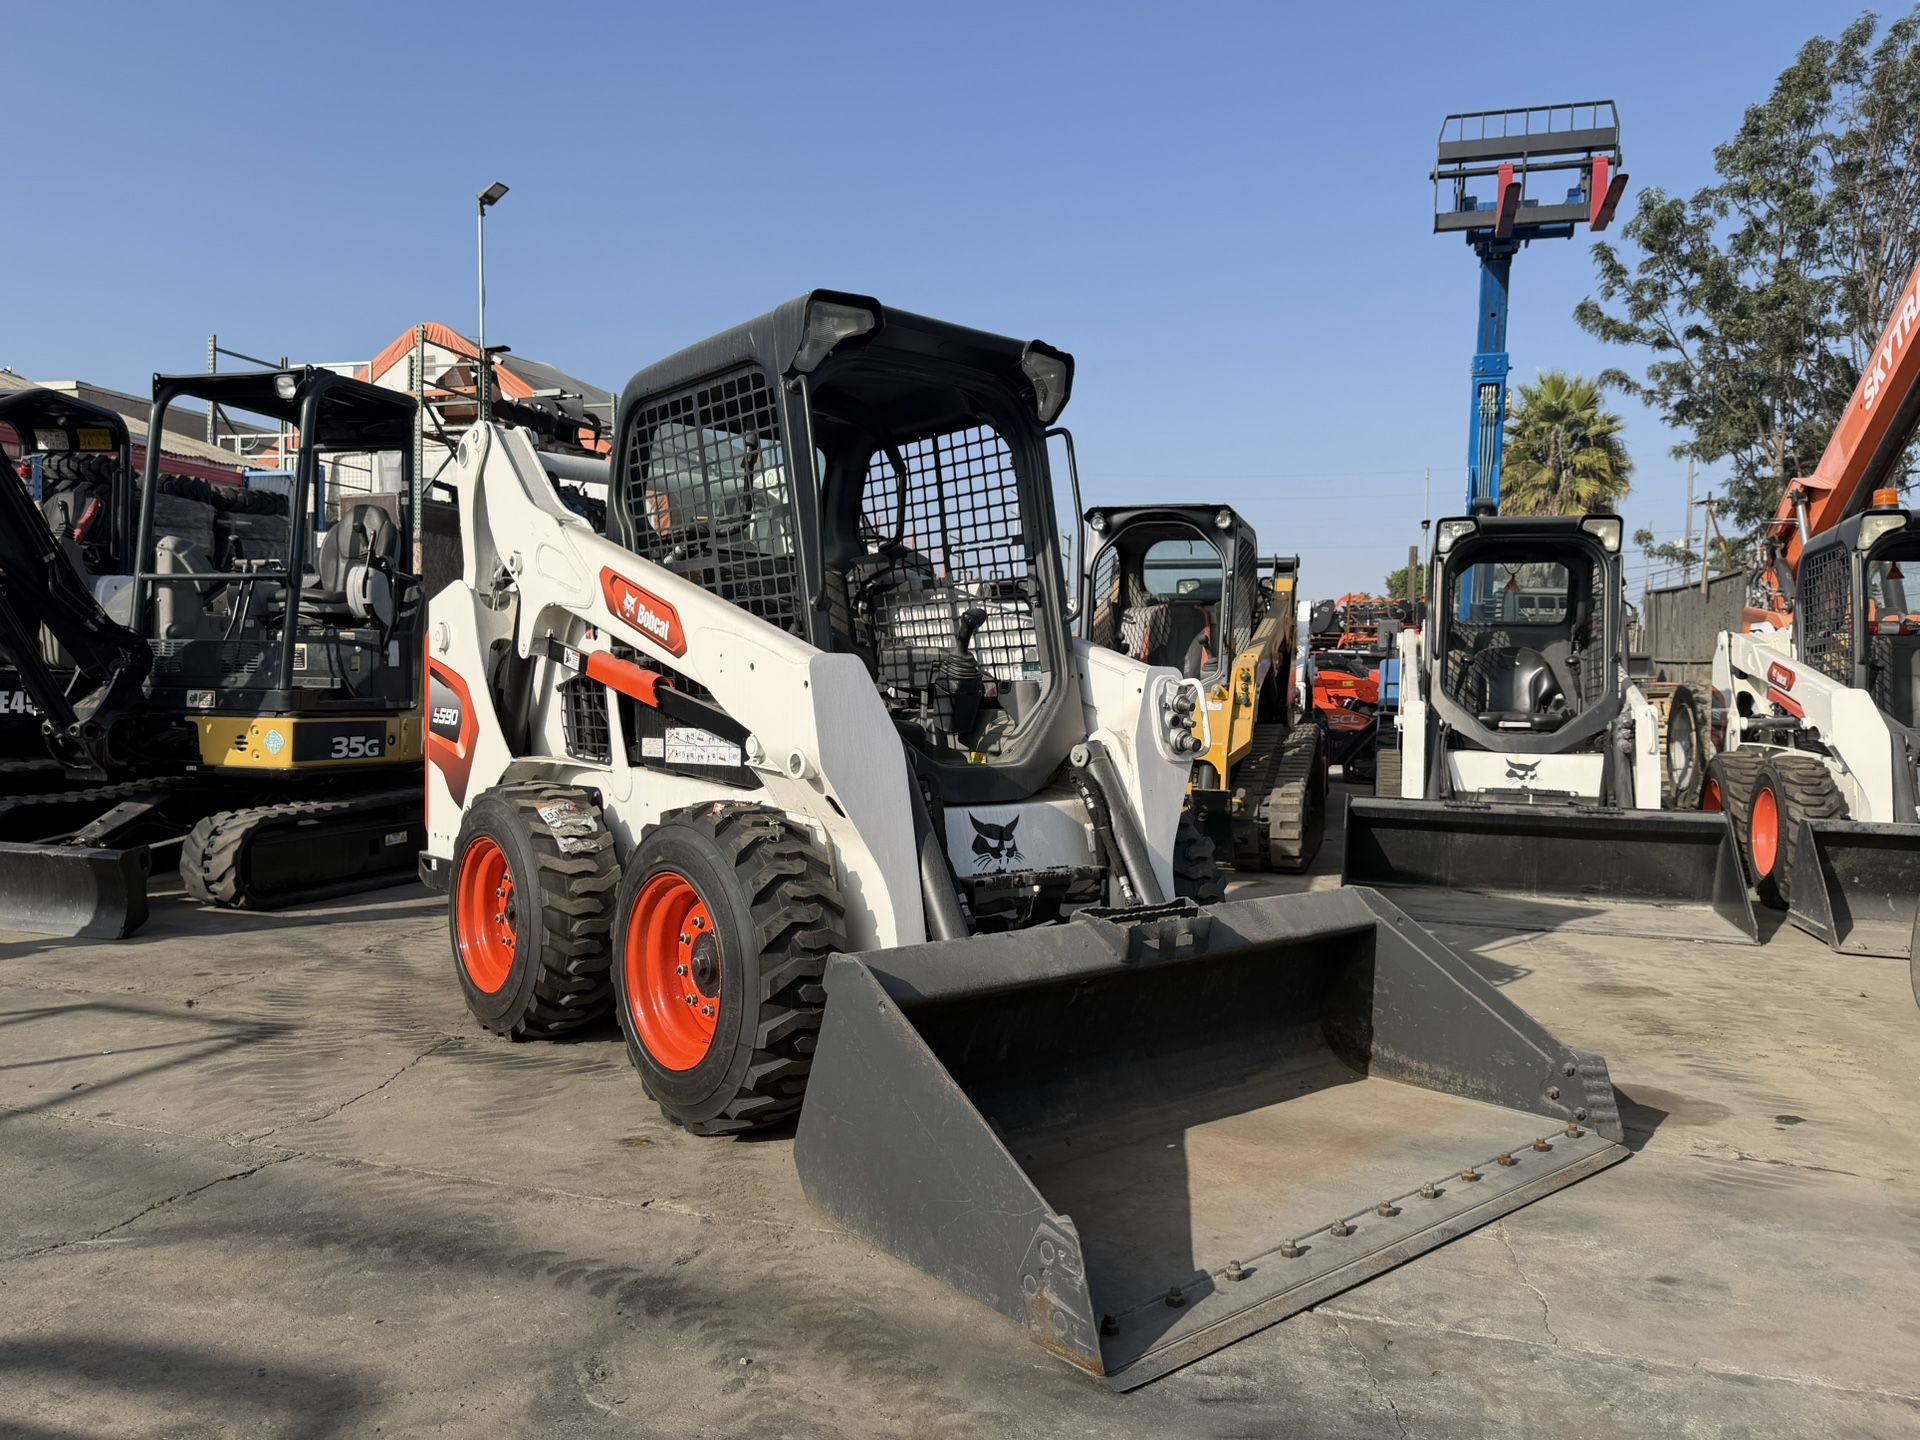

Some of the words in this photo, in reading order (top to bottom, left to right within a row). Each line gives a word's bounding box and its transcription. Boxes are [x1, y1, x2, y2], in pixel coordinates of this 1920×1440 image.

[637, 603, 669, 640] Bobcat
[1330, 714, 1359, 723] SCL
[331, 736, 379, 758] 35G
